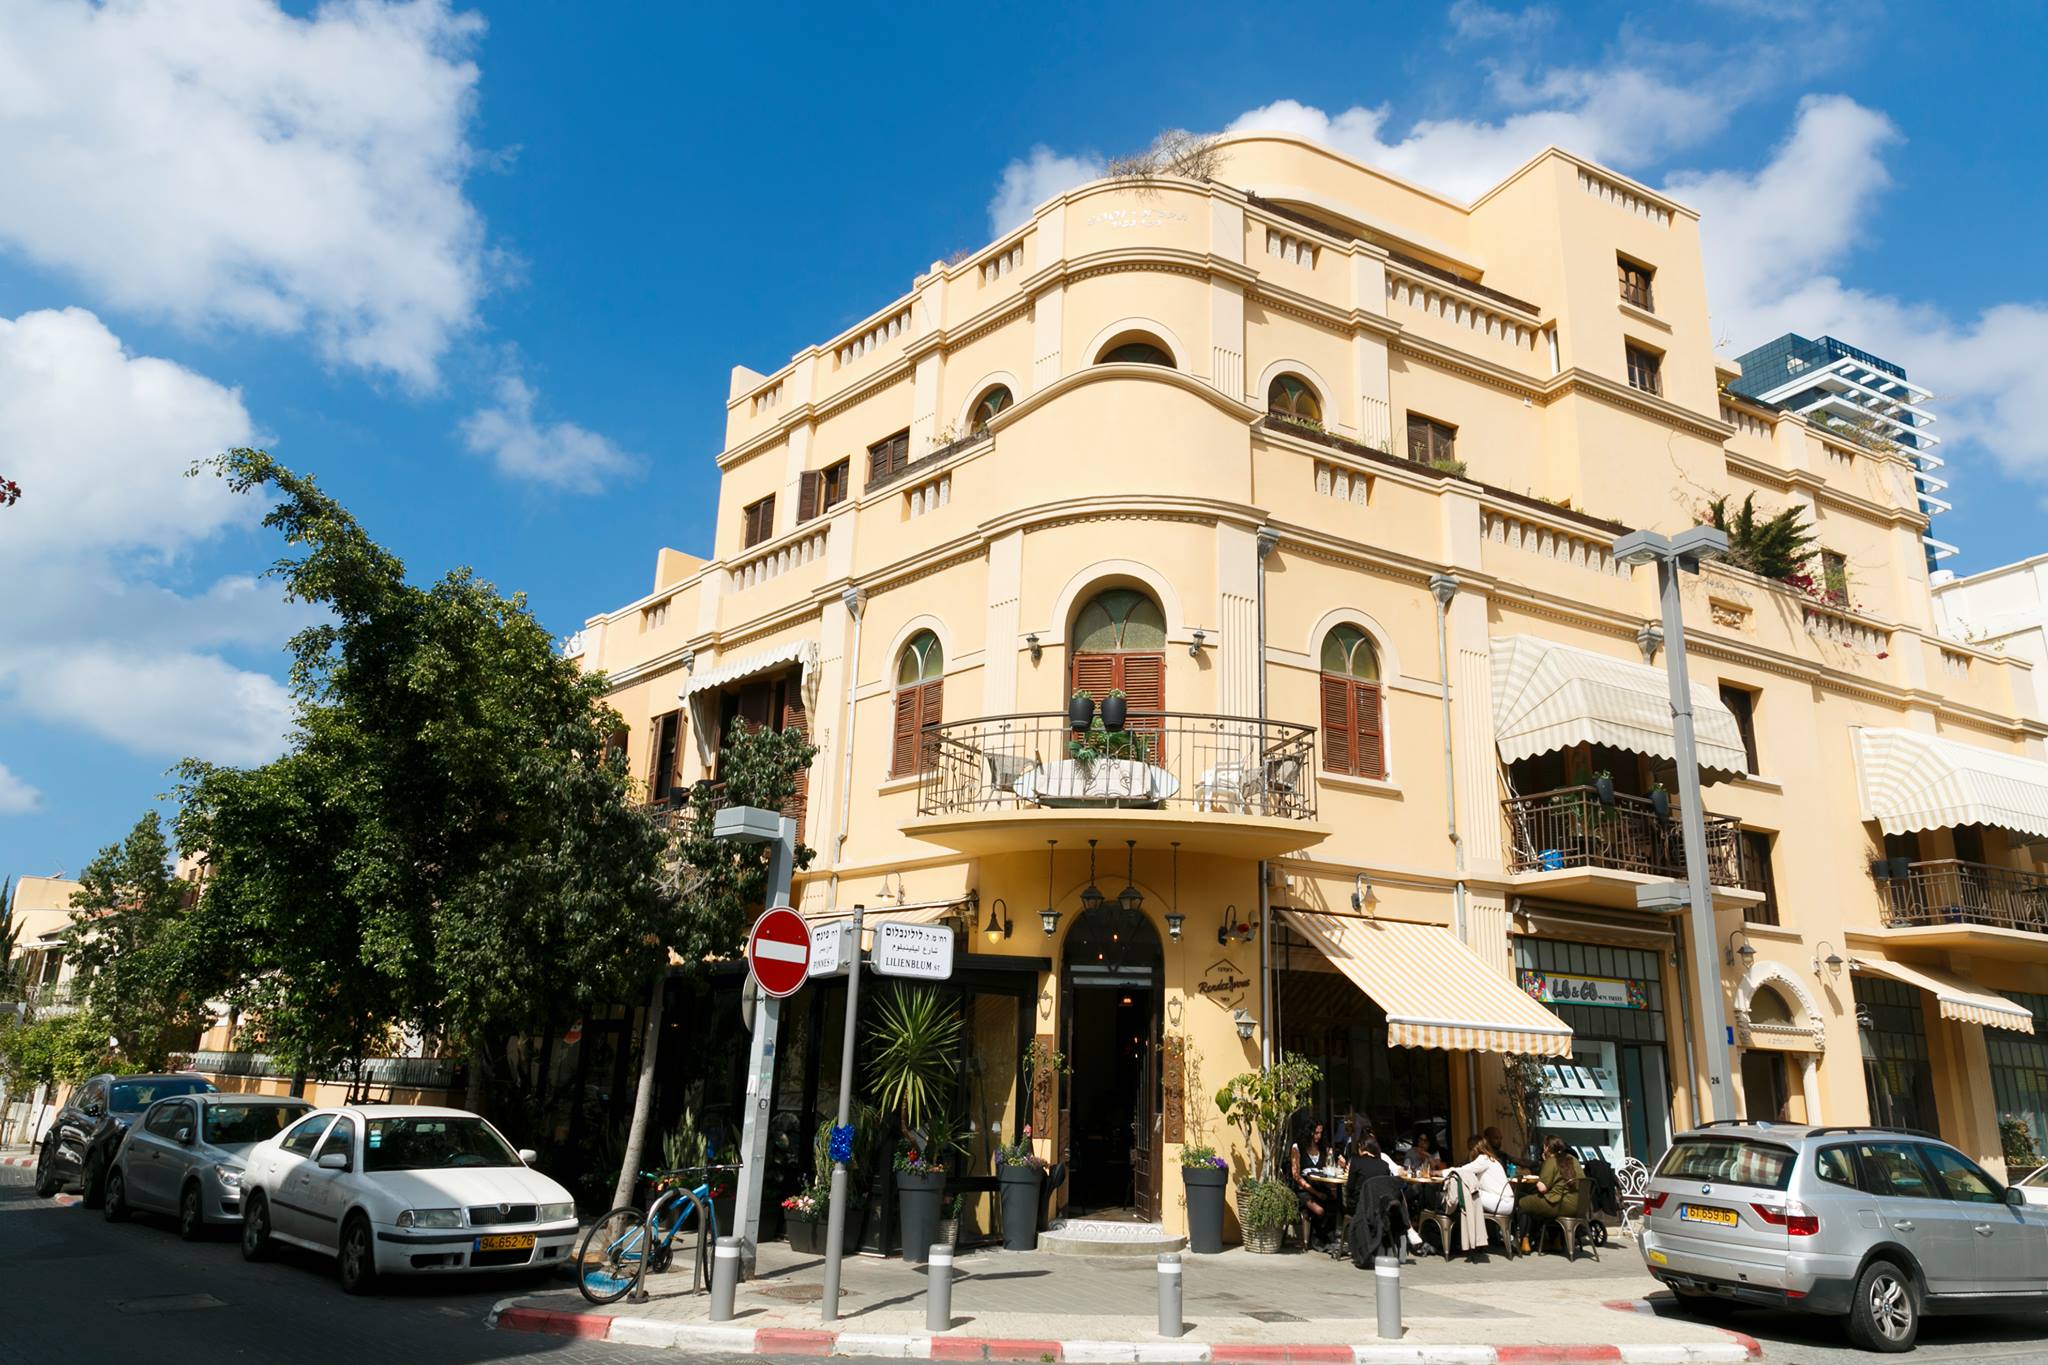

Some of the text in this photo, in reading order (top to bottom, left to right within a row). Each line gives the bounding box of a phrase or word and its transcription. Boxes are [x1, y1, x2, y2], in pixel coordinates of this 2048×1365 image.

[816, 929, 830, 941] פינס
[885, 926, 923, 939] לילינבלום
[885, 957, 932, 970] LILIENBLUM
